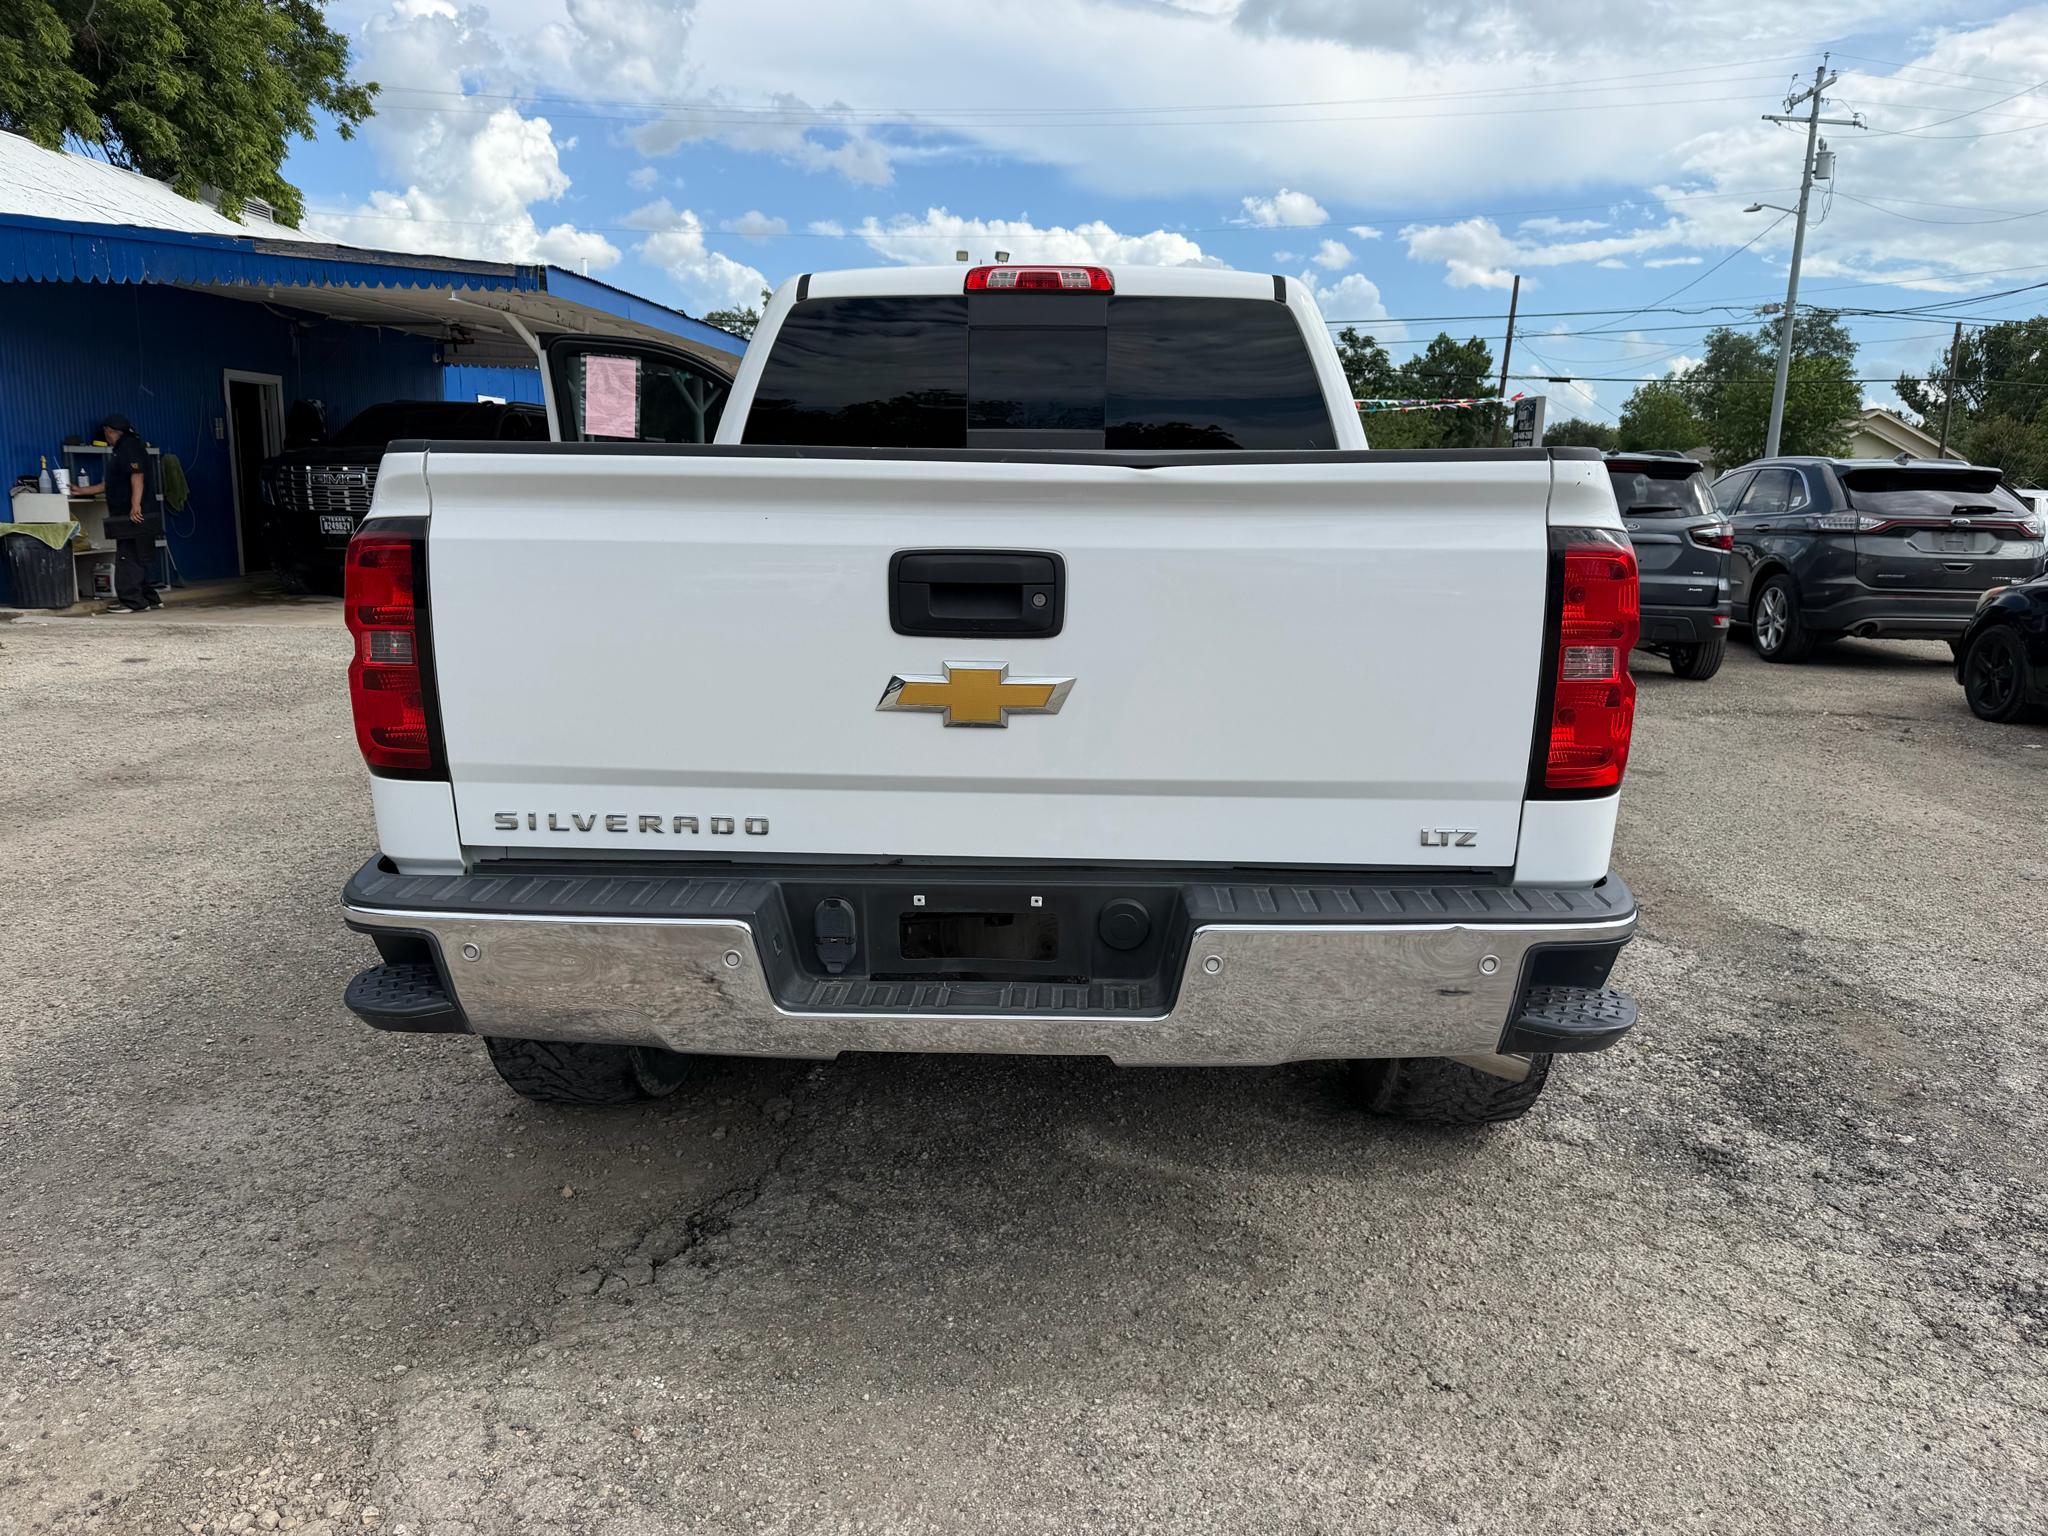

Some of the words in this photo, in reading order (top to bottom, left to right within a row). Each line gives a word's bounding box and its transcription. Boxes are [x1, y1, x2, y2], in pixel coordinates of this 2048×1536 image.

[311, 473, 362, 485] GMC
[494, 811, 770, 836] SILVERADO
[1420, 828, 1478, 847] LTZ
